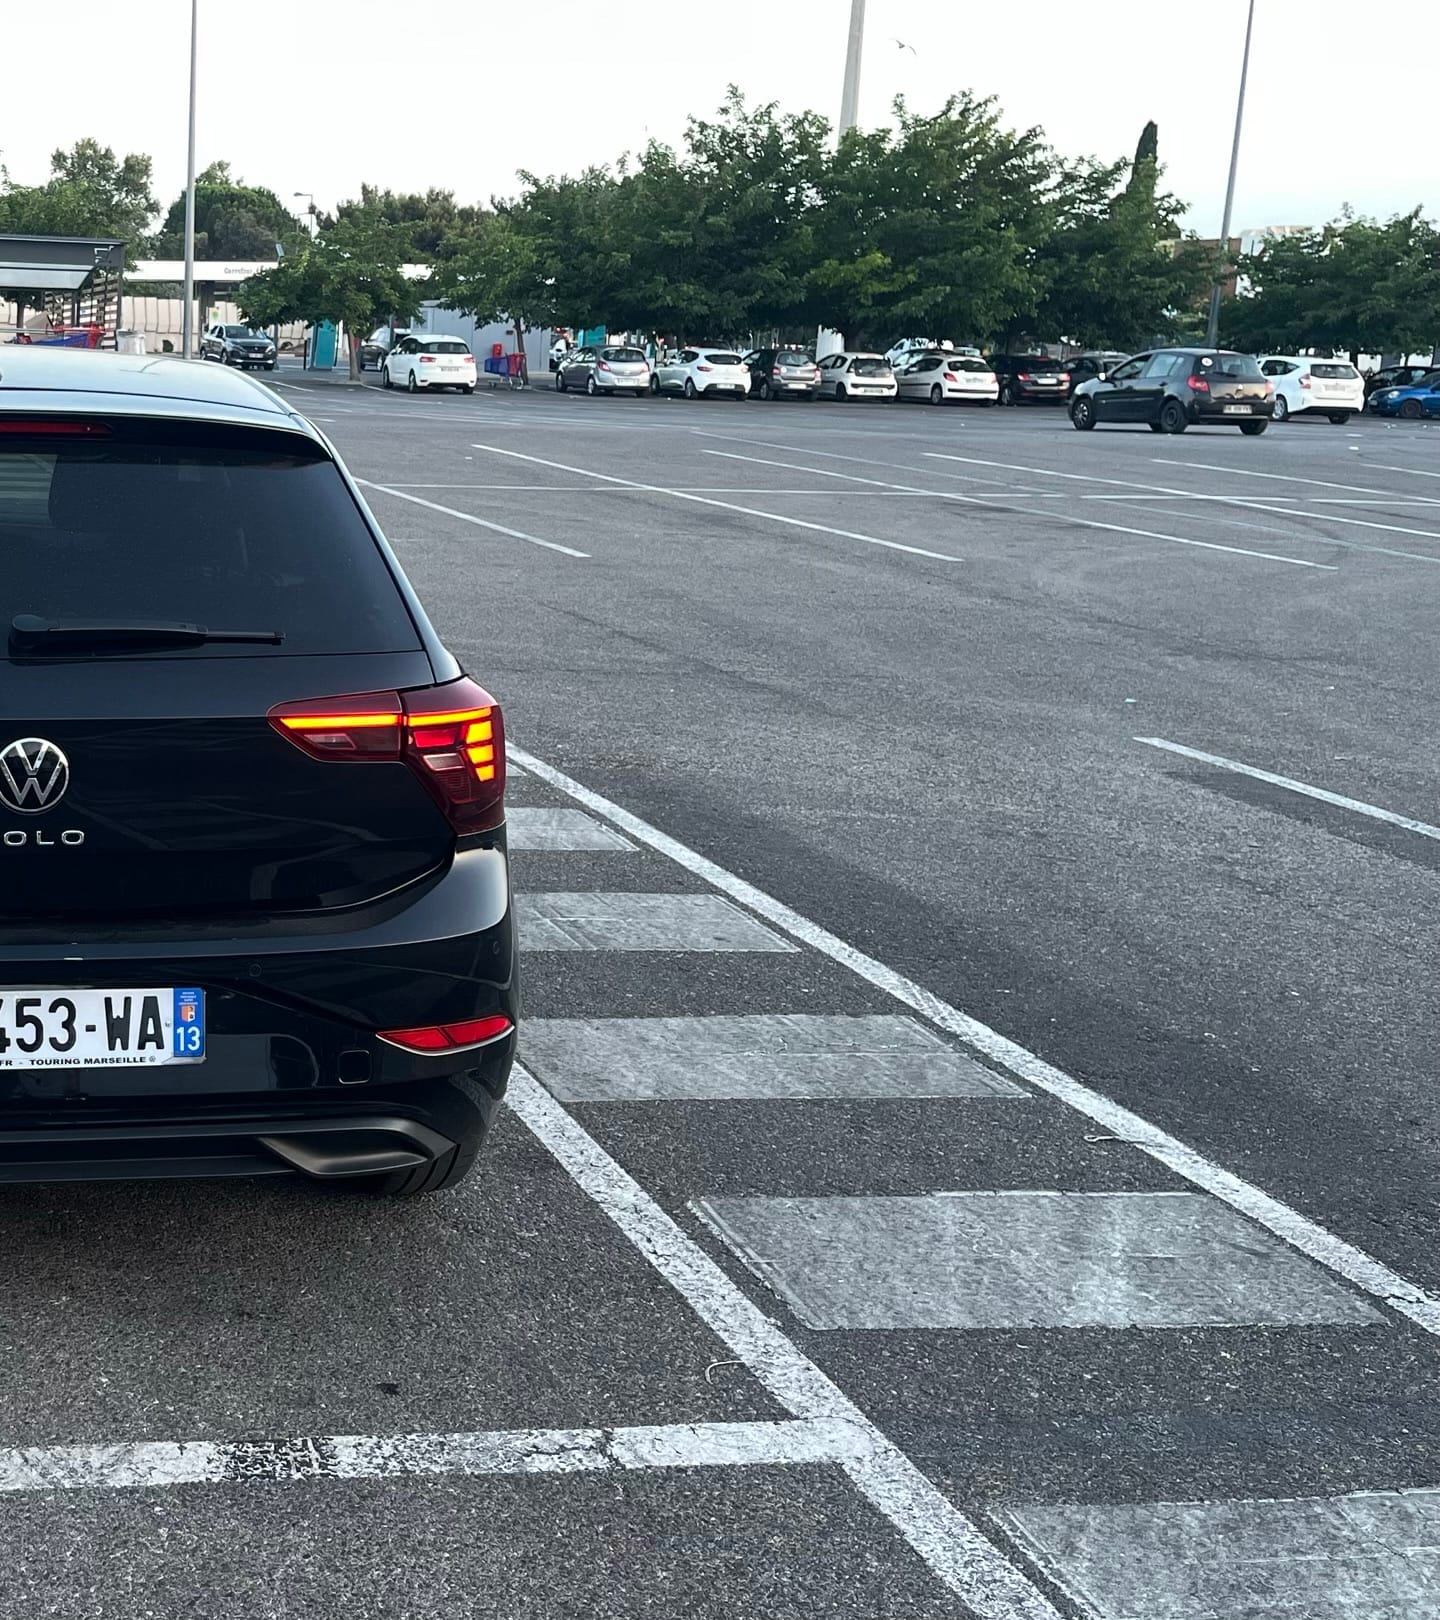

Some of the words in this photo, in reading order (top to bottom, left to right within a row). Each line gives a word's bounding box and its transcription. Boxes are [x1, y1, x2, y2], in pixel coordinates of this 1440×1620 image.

[175, 1025, 201, 1052] 13
[29, 1058, 81, 1066] TOURING
[83, 1056, 148, 1065] MARSEILLE
